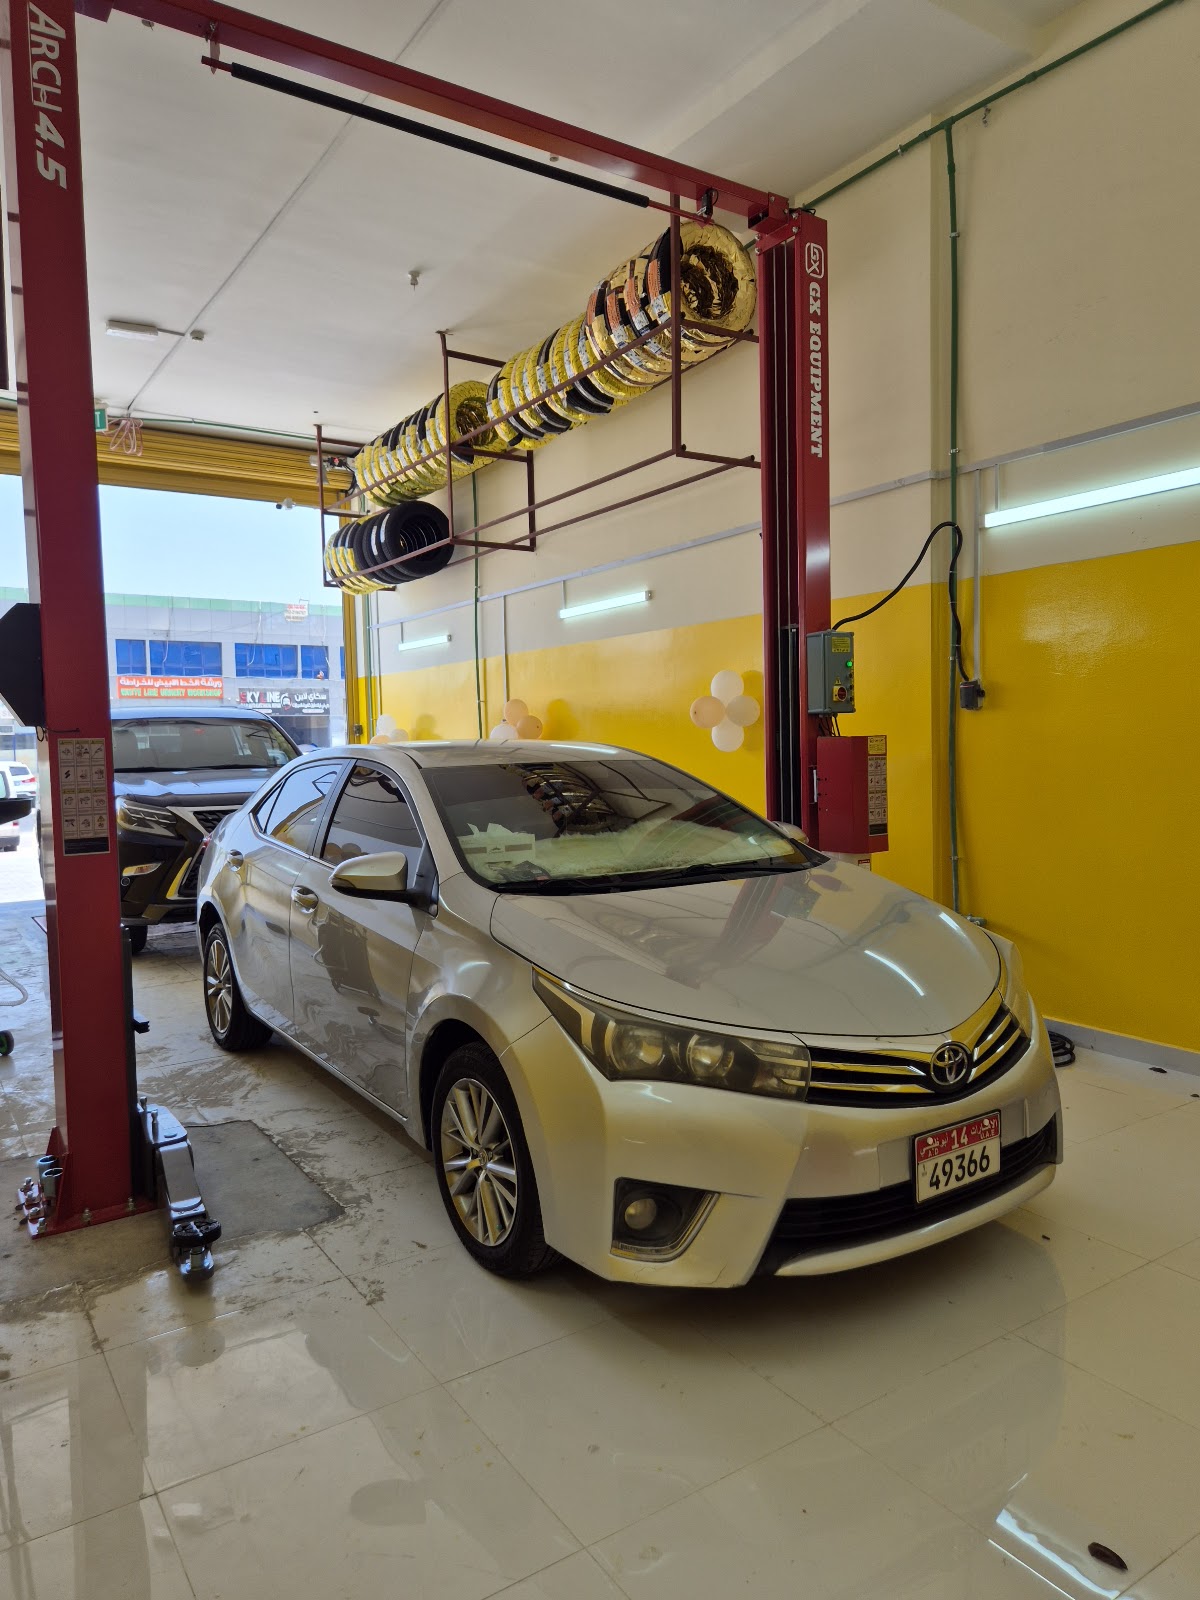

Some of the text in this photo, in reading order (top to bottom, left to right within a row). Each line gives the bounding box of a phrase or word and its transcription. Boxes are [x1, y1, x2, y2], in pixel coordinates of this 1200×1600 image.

[28, 1, 67, 190] ARCH 4.5
[809, 281, 823, 458] GX EQUIPMENT
[119, 677, 153, 687] للخراطة
[179, 678, 200, 686] الخط
[200, 677, 222, 688] ورشة
[951, 1126, 969, 1150] 14
[929, 1145, 991, 1190] 49366
